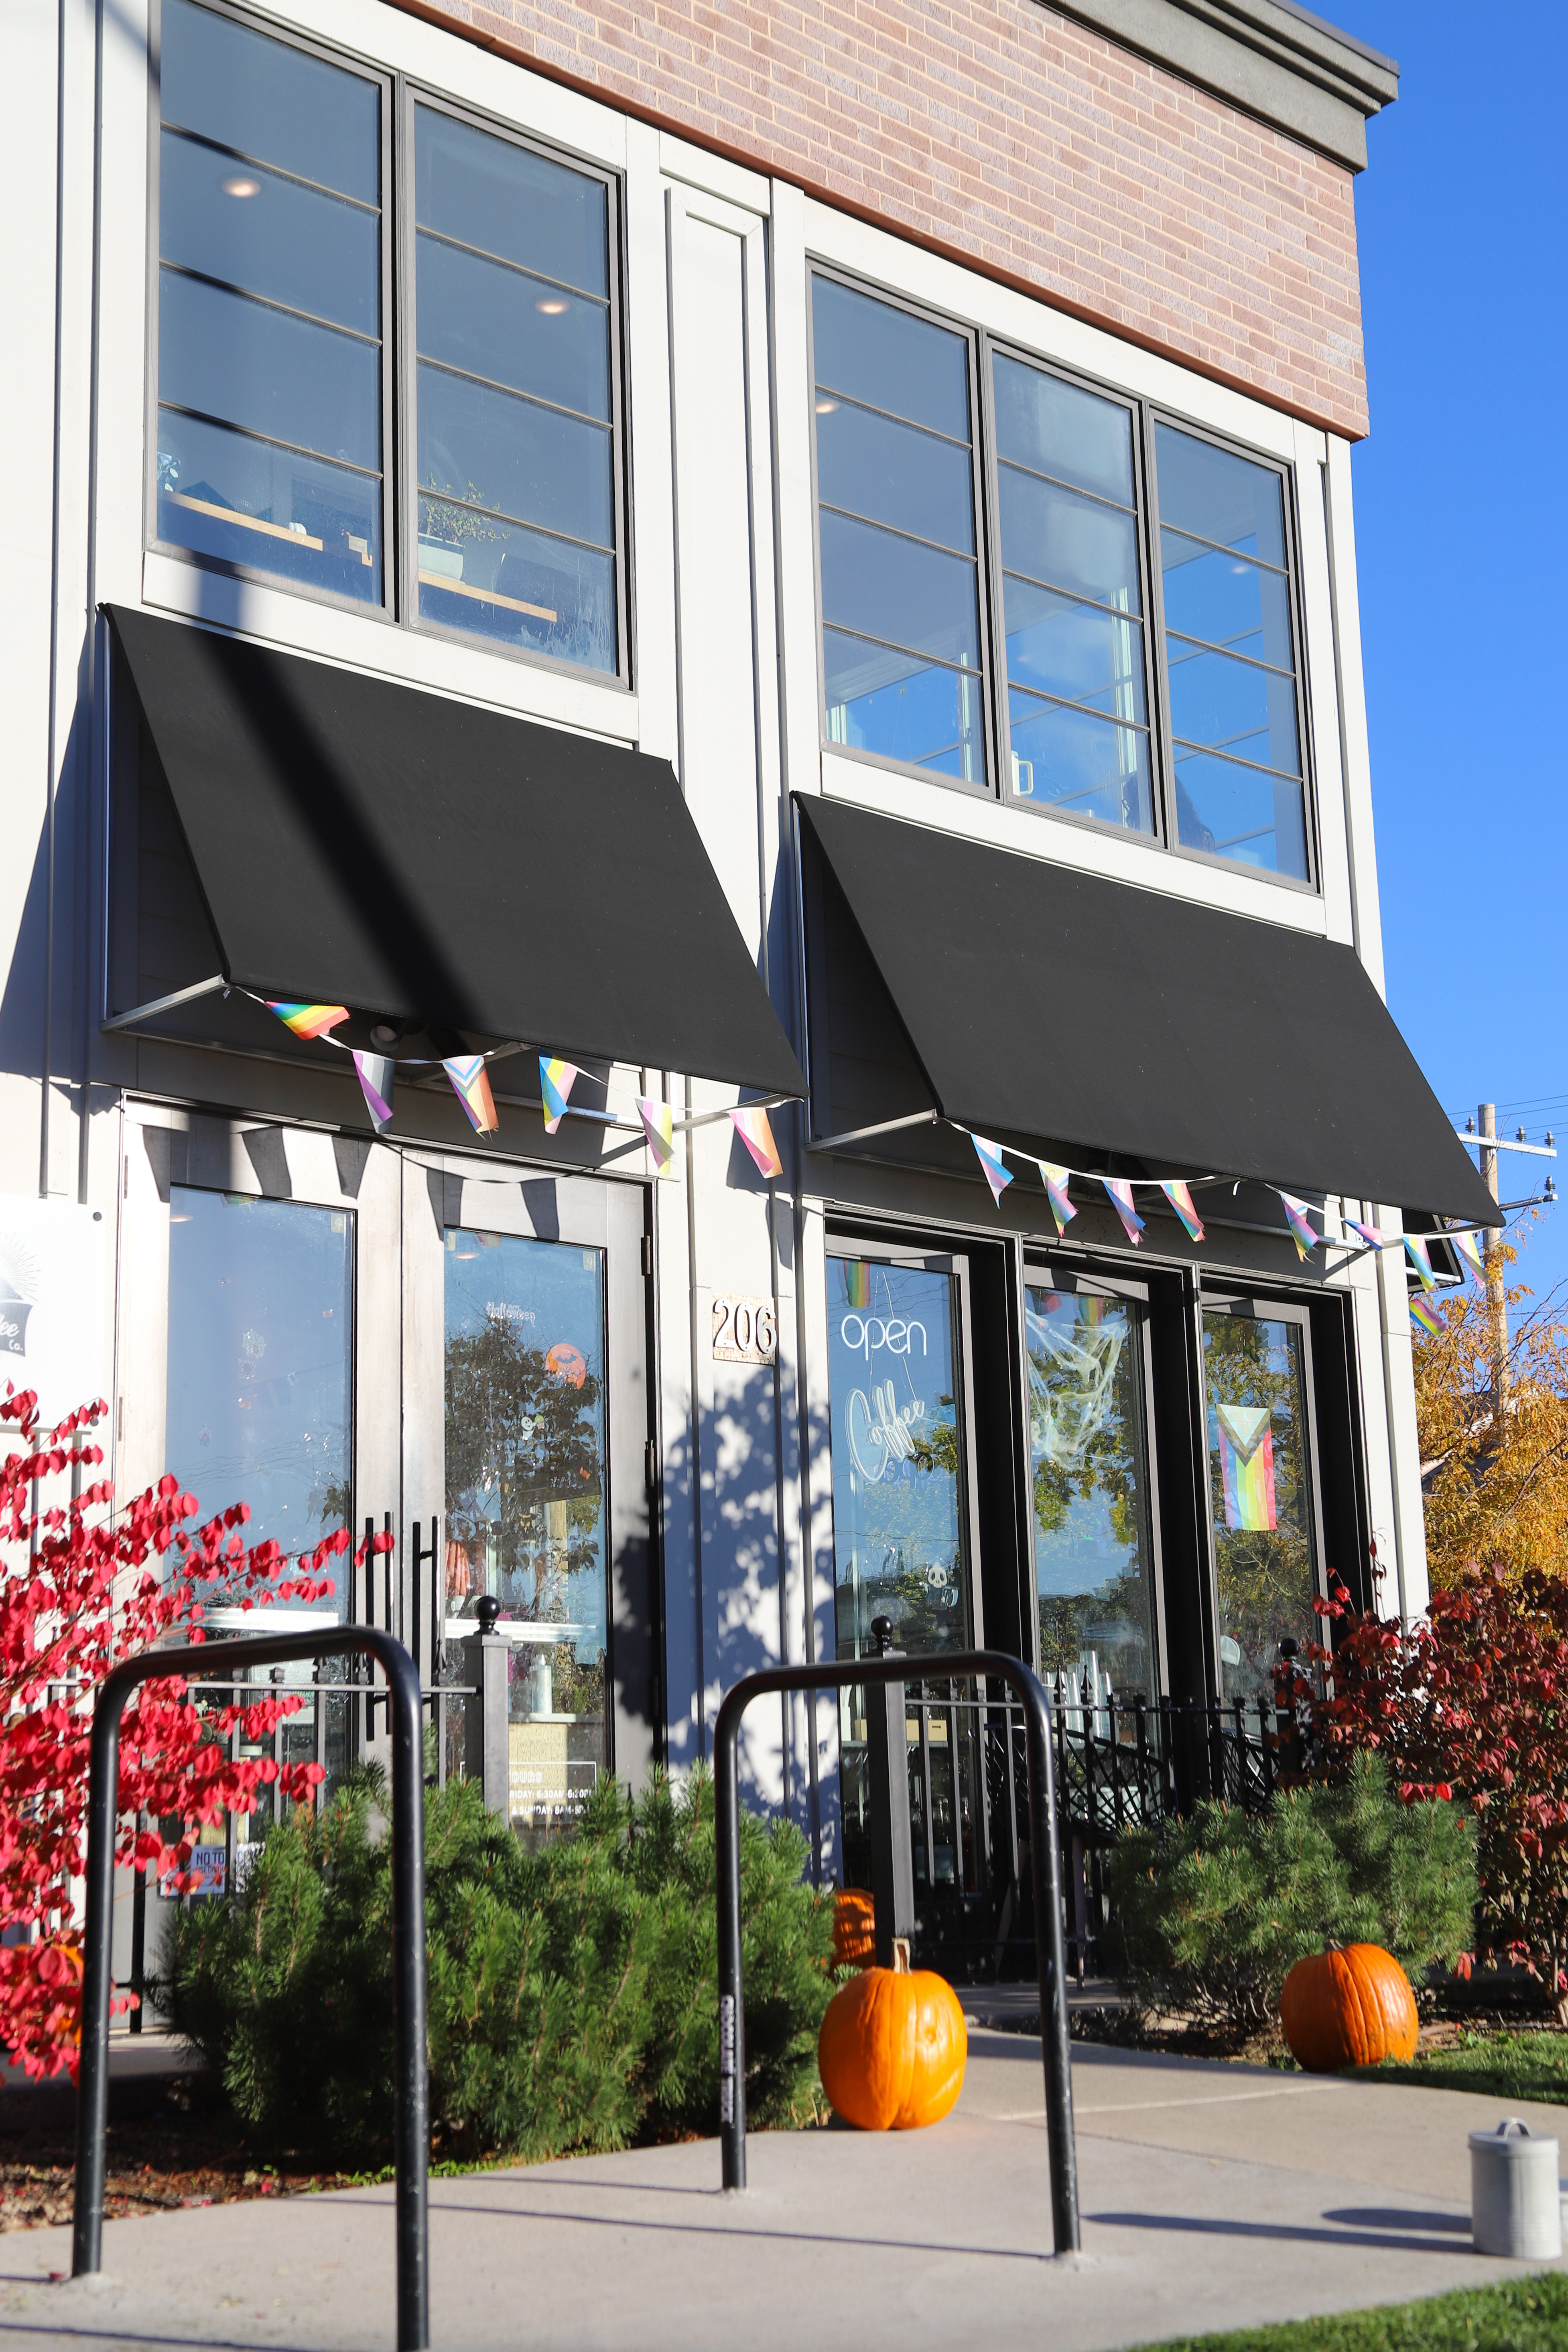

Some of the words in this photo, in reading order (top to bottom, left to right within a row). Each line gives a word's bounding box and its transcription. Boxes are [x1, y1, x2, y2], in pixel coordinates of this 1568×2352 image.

[486, 1301, 536, 1322] Halloween
[713, 1298, 777, 1354] 206
[841, 1314, 927, 1361] open
[845, 1378, 925, 1483] Coffee
[510, 1789, 534, 1799] RIDAY:
[519, 1806, 552, 1815] SUNDAY:
[196, 1852, 210, 1865] NO
